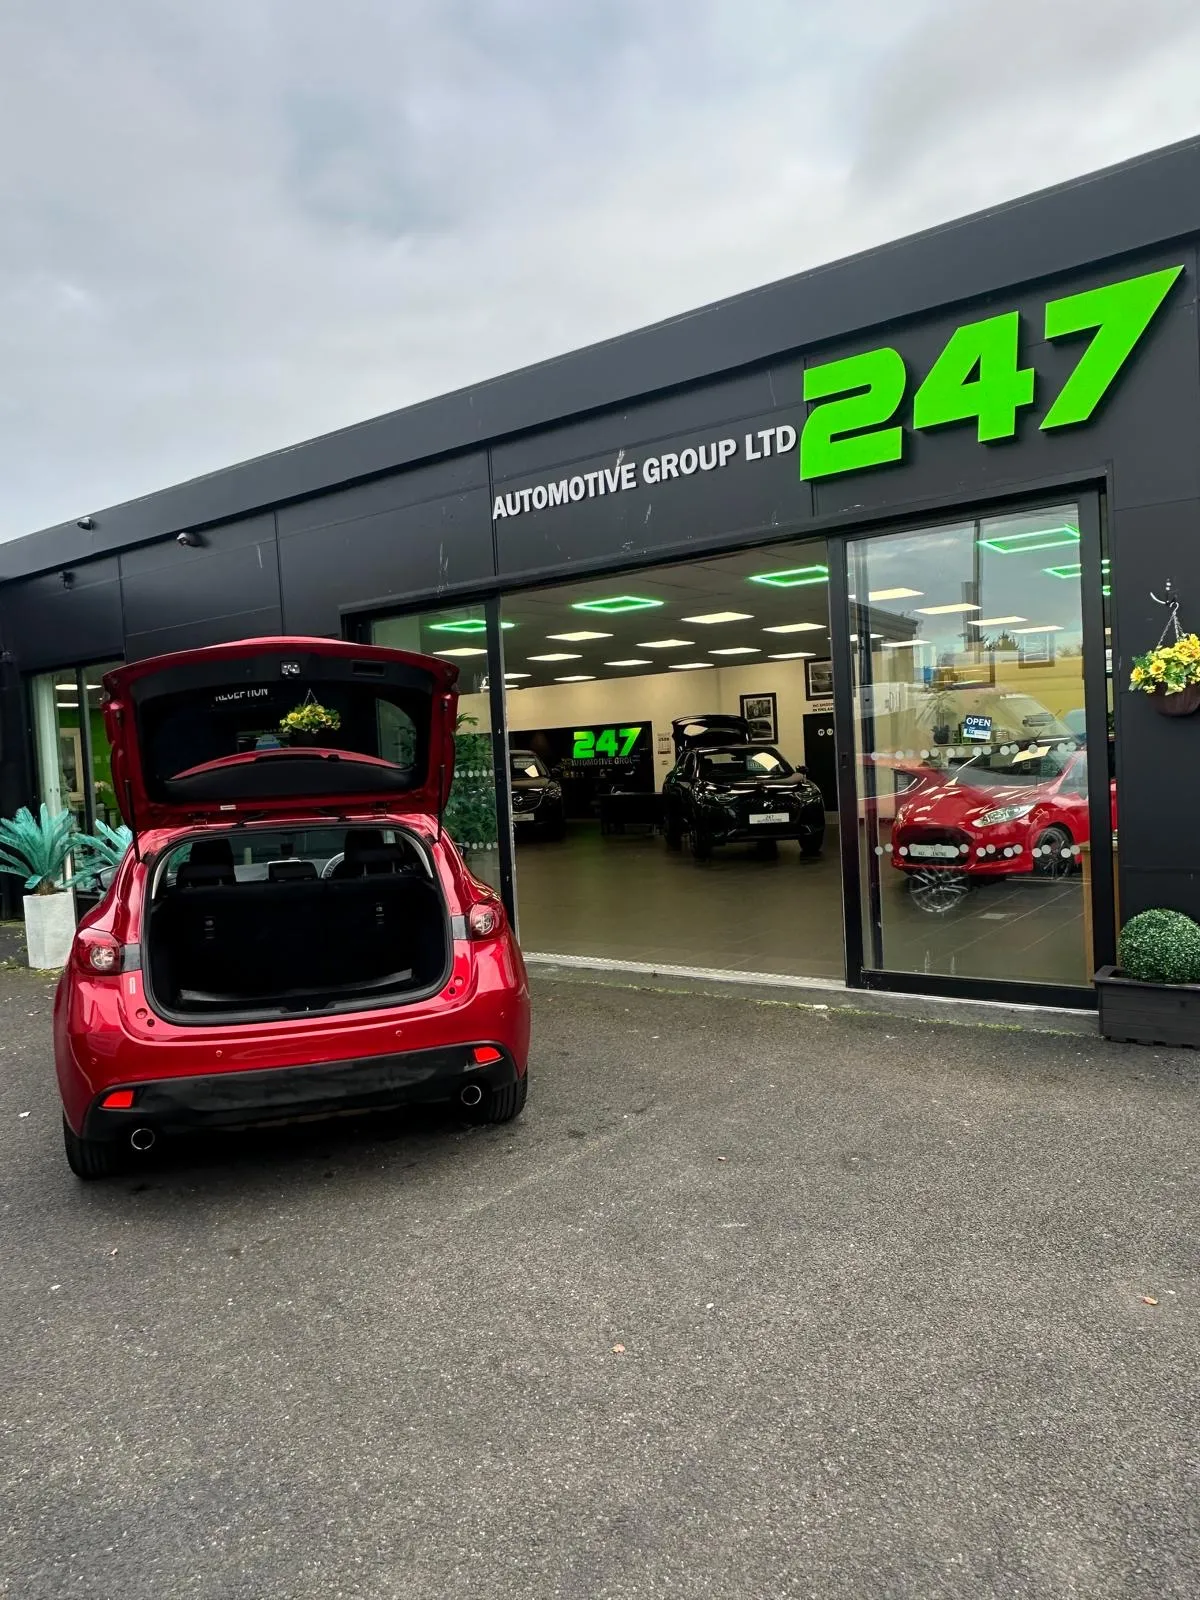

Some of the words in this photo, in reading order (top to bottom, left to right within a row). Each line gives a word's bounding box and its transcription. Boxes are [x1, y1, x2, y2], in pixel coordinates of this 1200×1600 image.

[800, 265, 1185, 481] 247
[492, 463, 637, 520] AUTOMOTIVE
[642, 438, 736, 484] GROUP
[745, 424, 797, 461] LTD
[573, 727, 642, 758] 247
[966, 717, 991, 727] OPEN
